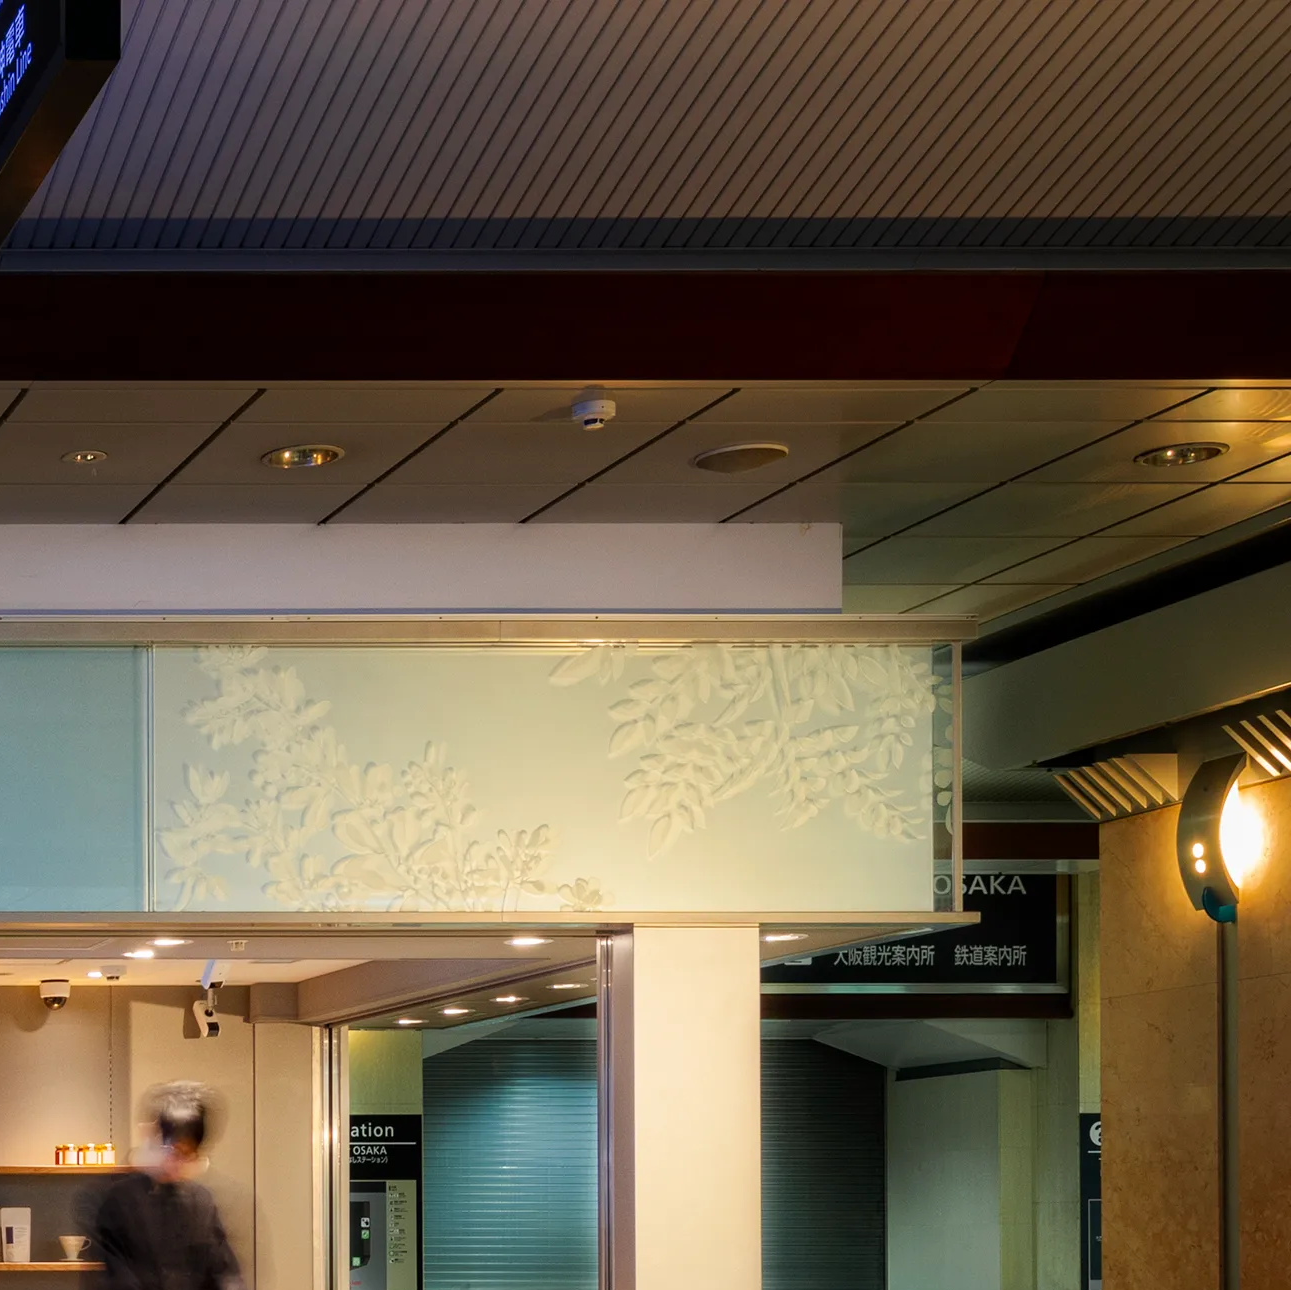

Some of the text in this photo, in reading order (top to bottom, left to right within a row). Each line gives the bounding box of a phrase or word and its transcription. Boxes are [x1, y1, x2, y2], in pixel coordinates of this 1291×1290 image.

[16, 42, 32, 84] Line
[834, 945, 1027, 967] 大阪観光案内所 鉄道案内所
[353, 1146, 387, 1155] OSAKA
